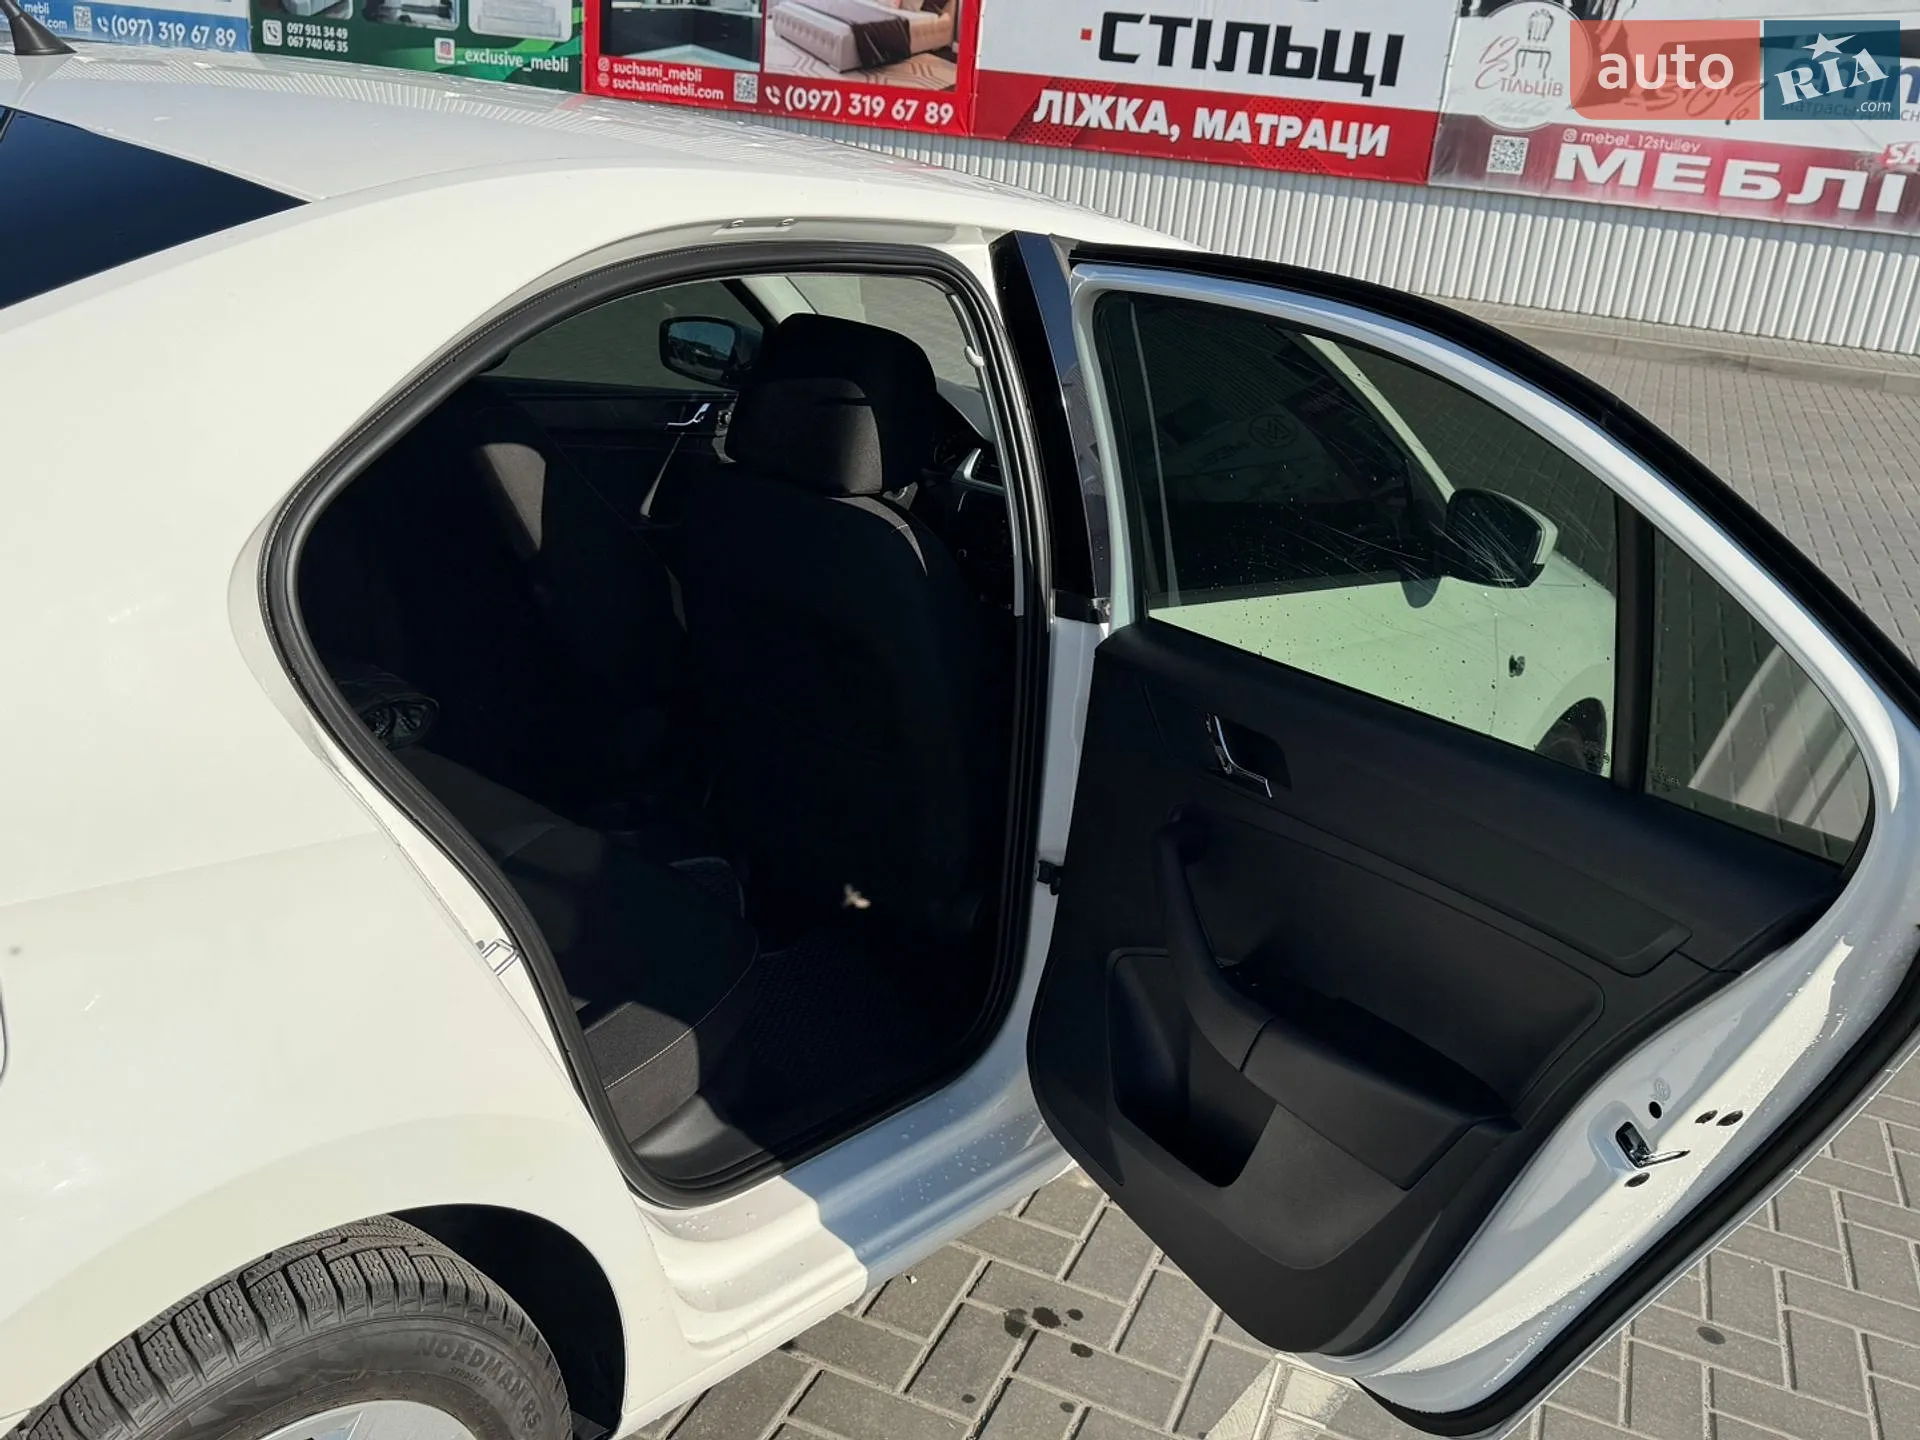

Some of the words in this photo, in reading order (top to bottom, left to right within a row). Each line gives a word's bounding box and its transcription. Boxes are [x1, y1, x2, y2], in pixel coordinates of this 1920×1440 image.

[112, 15, 153, 41] (097)
[159, 20, 185, 41] 319
[190, 24, 210, 44] 67
[215, 27, 236, 47] 89
[286, 22, 304, 34] 097
[305, 24, 322, 36] 931
[323, 26, 335, 38] 34
[286, 35, 304, 48] 067
[336, 41, 349, 53] 35
[1098, 11, 1406, 97] СТІЛЬЦІ
[612, 61, 703, 83] suchasni_mebli
[612, 77, 724, 101] suchasnimebli.com
[785, 85, 842, 116] (097)
[848, 93, 886, 118] 319
[891, 98, 919, 122] 67
[924, 102, 954, 125] 89
[1033, 88, 1182, 143] ЛІЖКА,
[1192, 107, 1392, 159] МАТРАЦИ
[1553, 142, 1907, 214] МЕБЛІ
